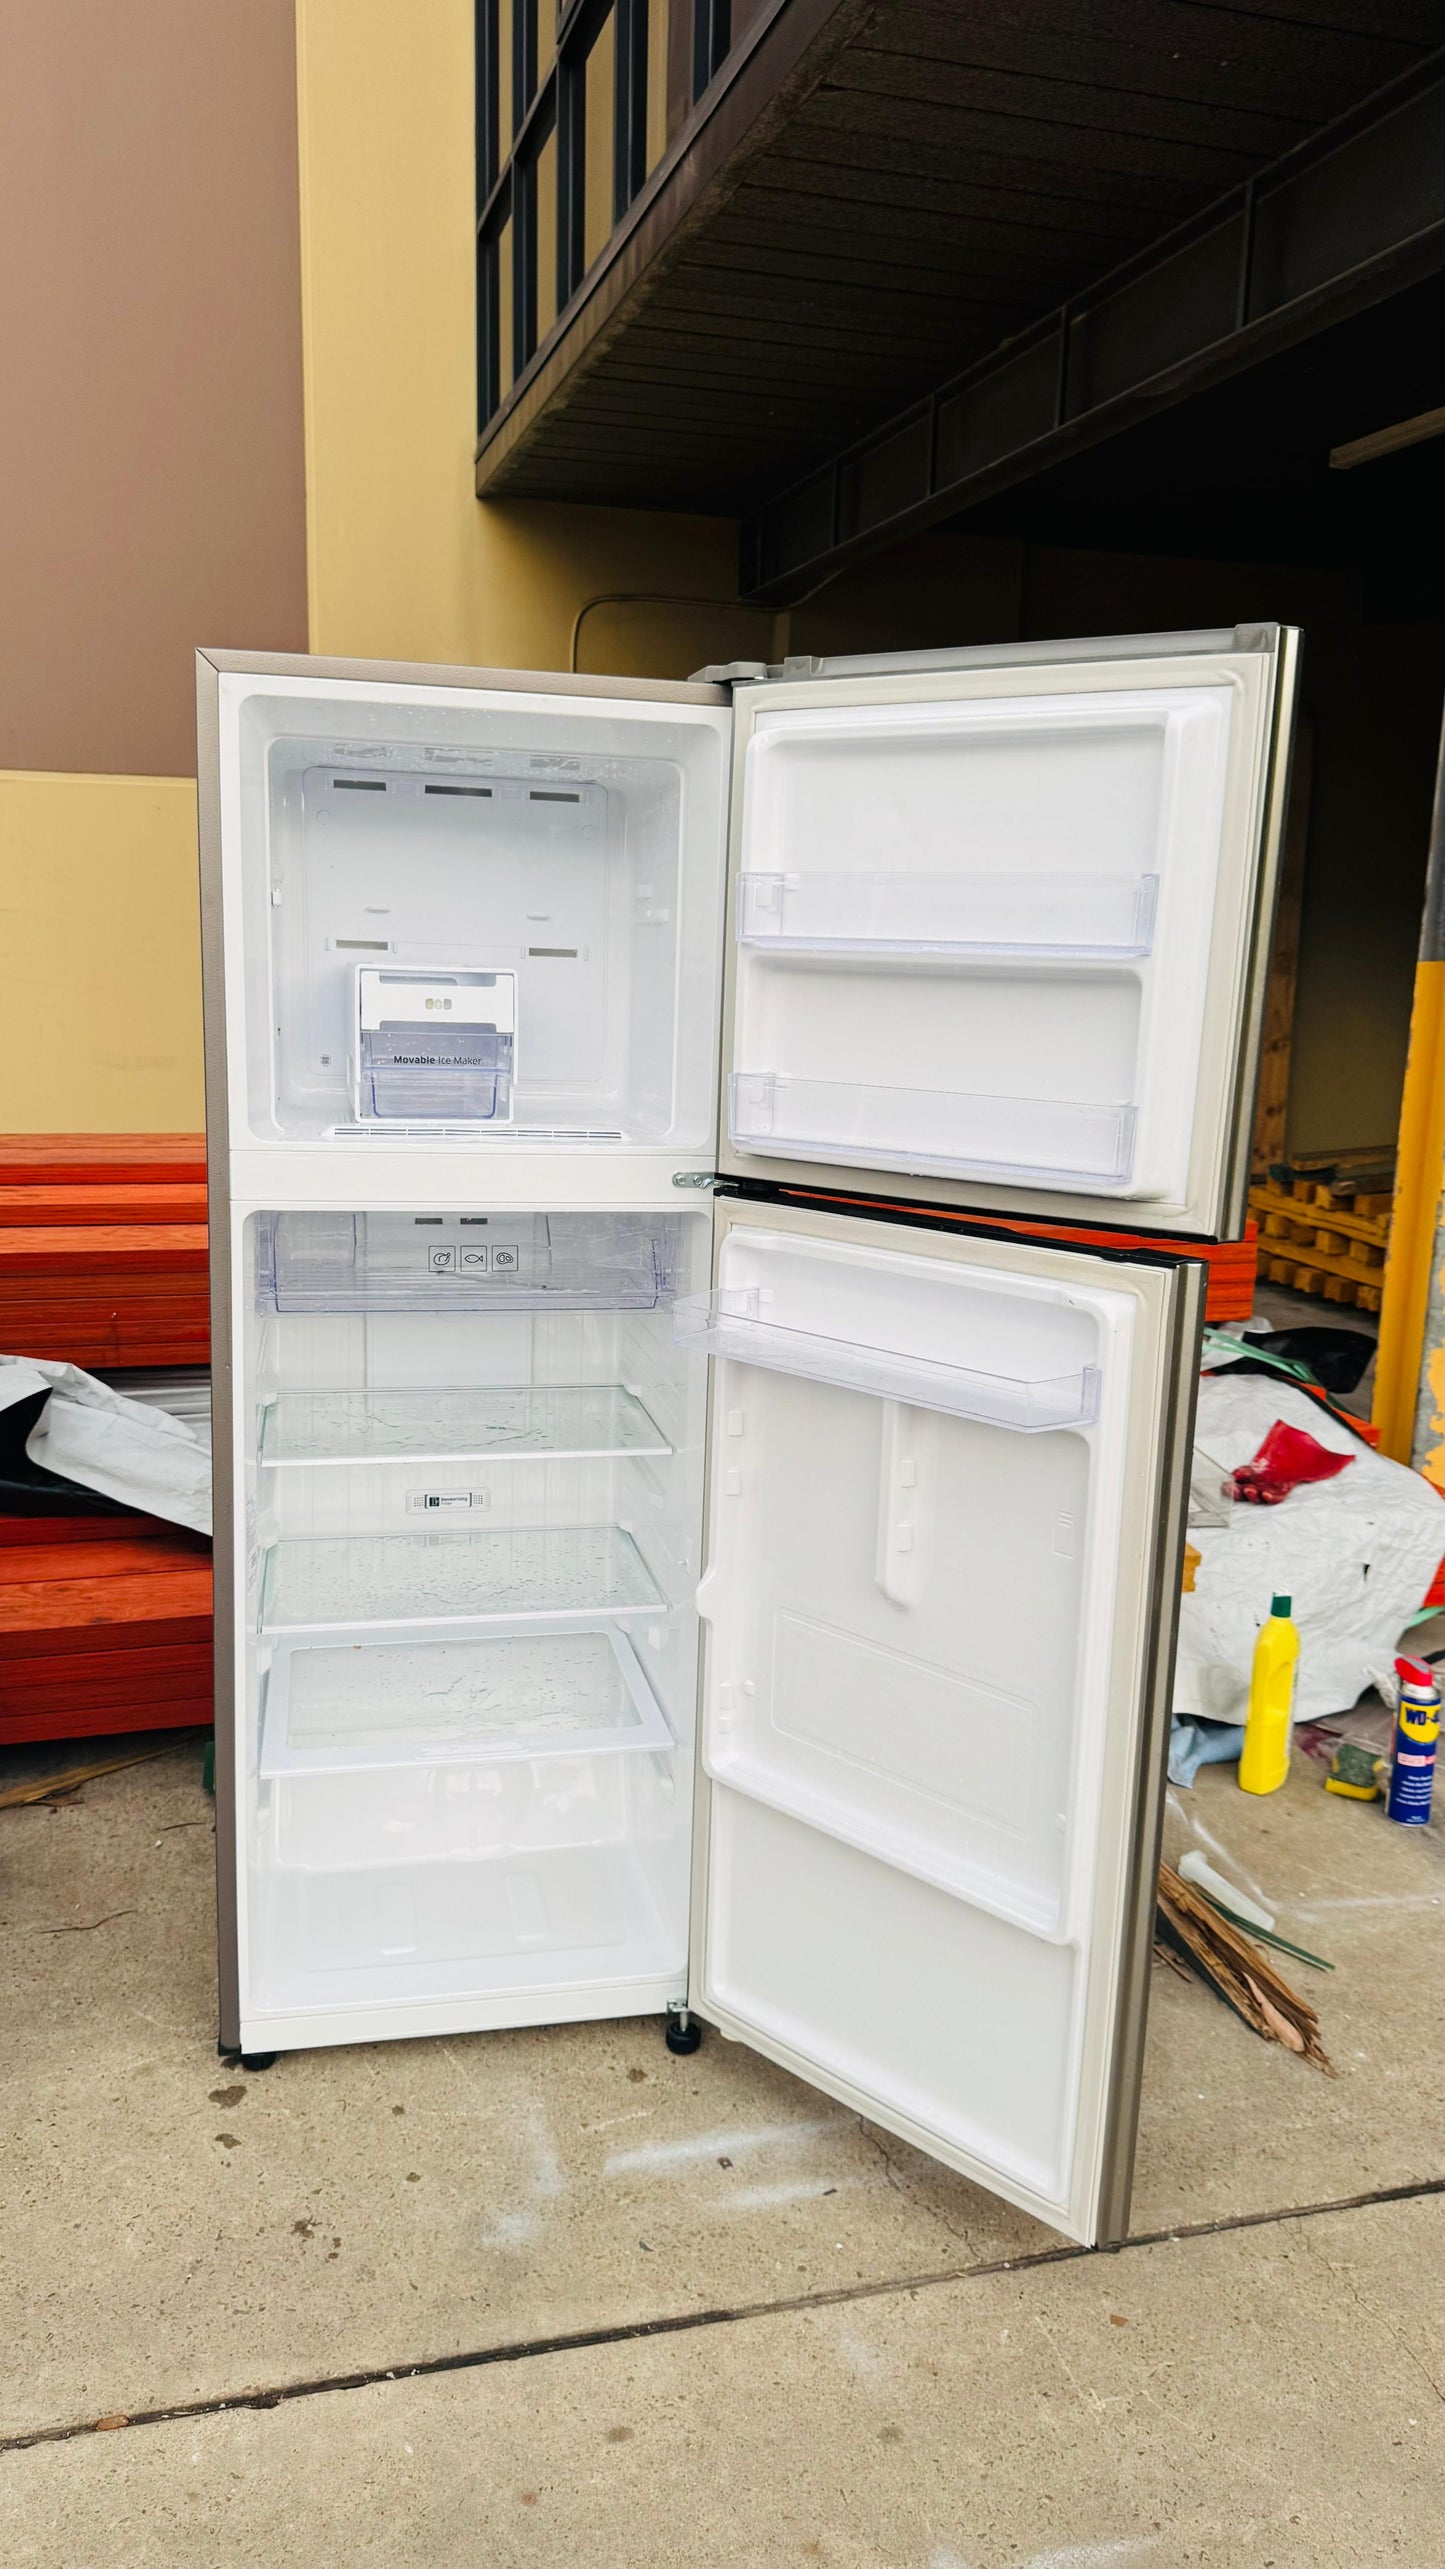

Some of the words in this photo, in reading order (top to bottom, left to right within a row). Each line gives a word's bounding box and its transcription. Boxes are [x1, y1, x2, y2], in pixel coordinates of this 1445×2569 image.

[393, 1055, 436, 1064] Movable
[438, 1056, 451, 1065] Ice
[453, 1056, 482, 1065] Maker
